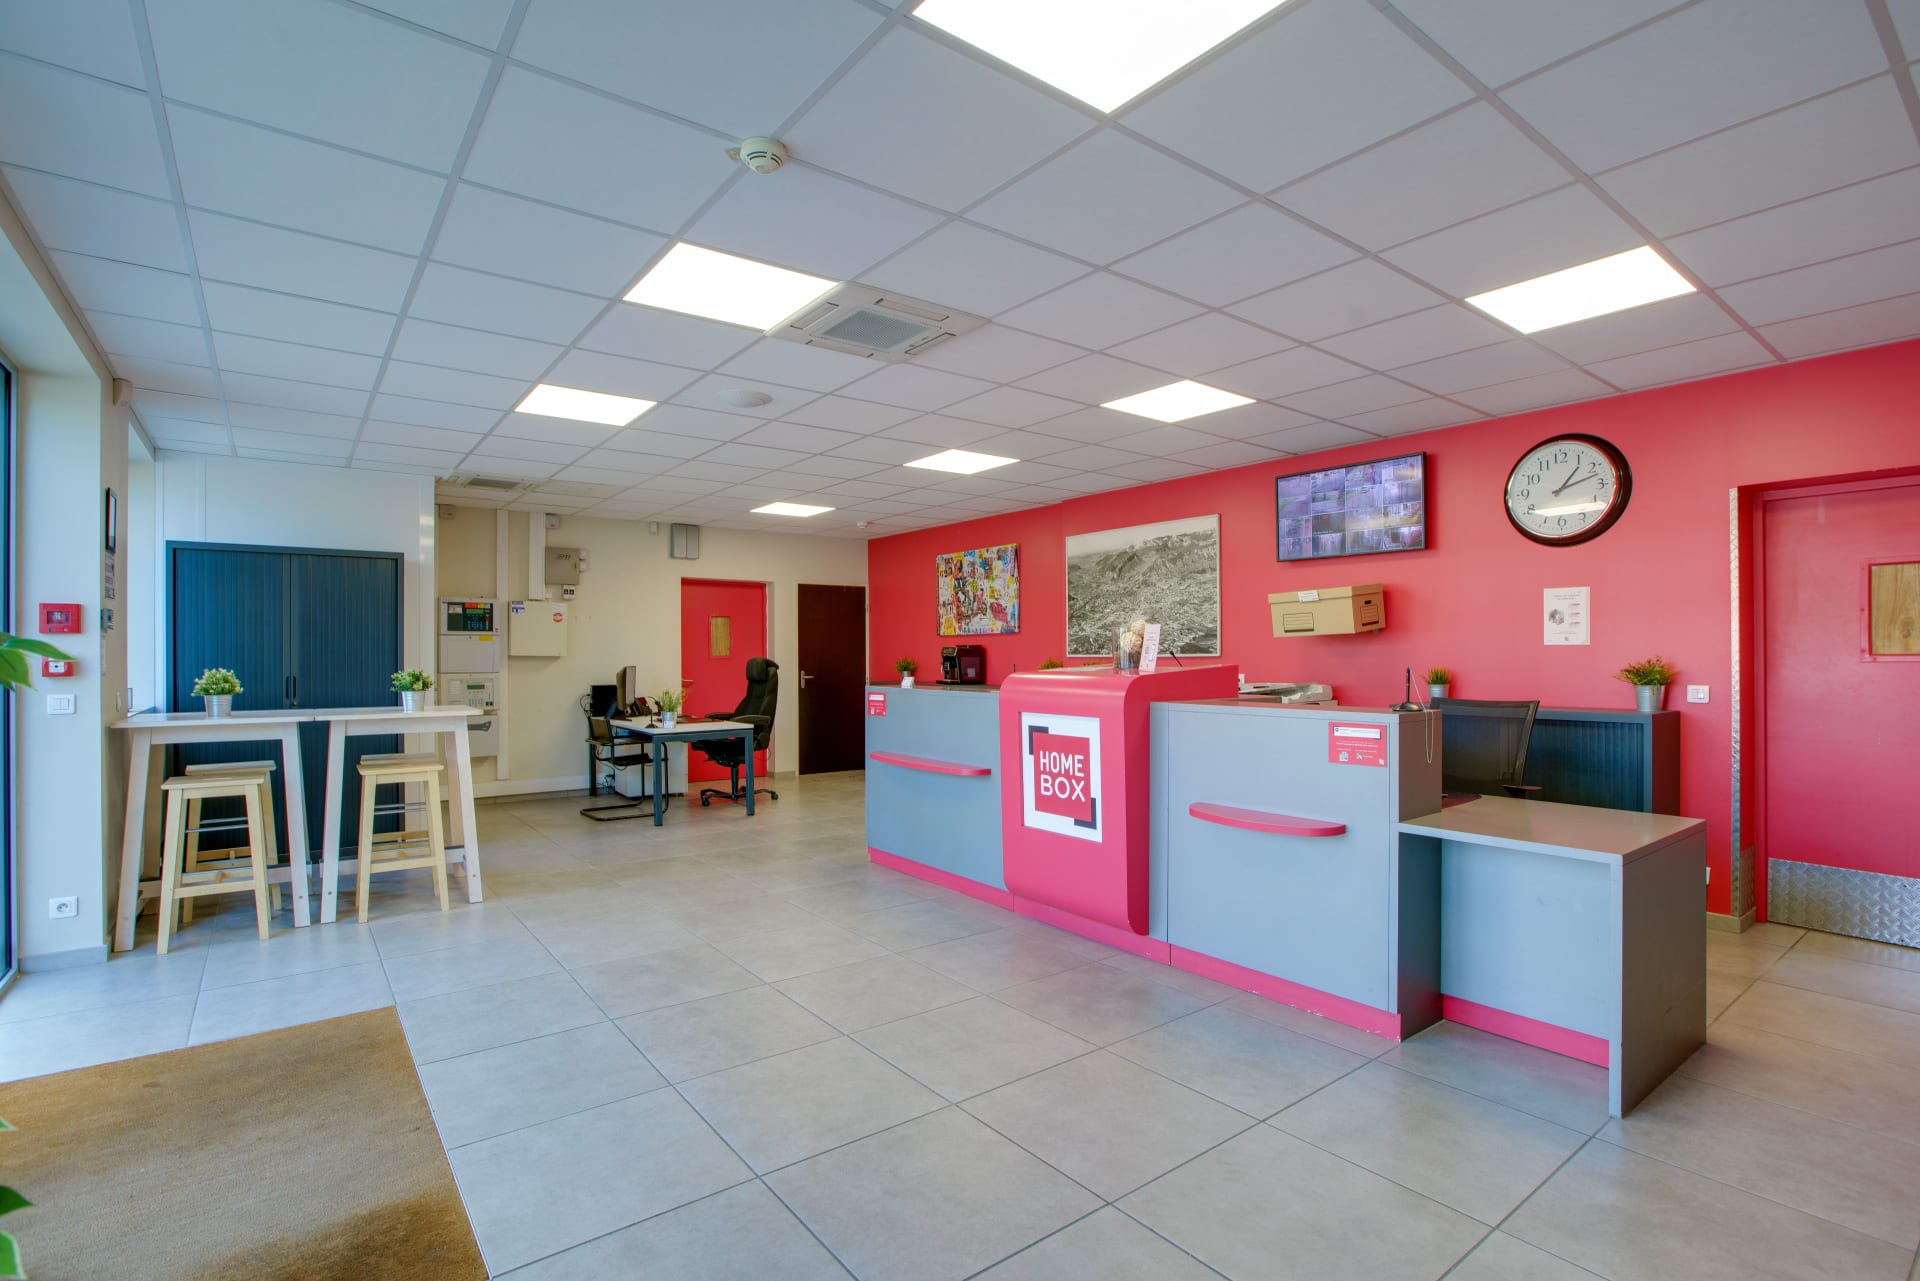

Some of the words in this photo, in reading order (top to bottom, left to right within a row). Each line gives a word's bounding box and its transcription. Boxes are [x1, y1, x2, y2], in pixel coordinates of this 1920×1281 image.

[1553, 451, 1568, 464] 12
[1576, 454, 1581, 465] 1
[1539, 459, 1549, 472] 11
[1588, 462, 1597, 474] 2
[1527, 474, 1540, 486] 10
[1596, 478, 1605, 490] 3
[1521, 488, 1530, 500] 9
[1527, 503, 1536, 515] 8
[1557, 514, 1567, 527] 6
[1039, 751, 1084, 777] HOME
[1041, 775, 1085, 802] BOX
